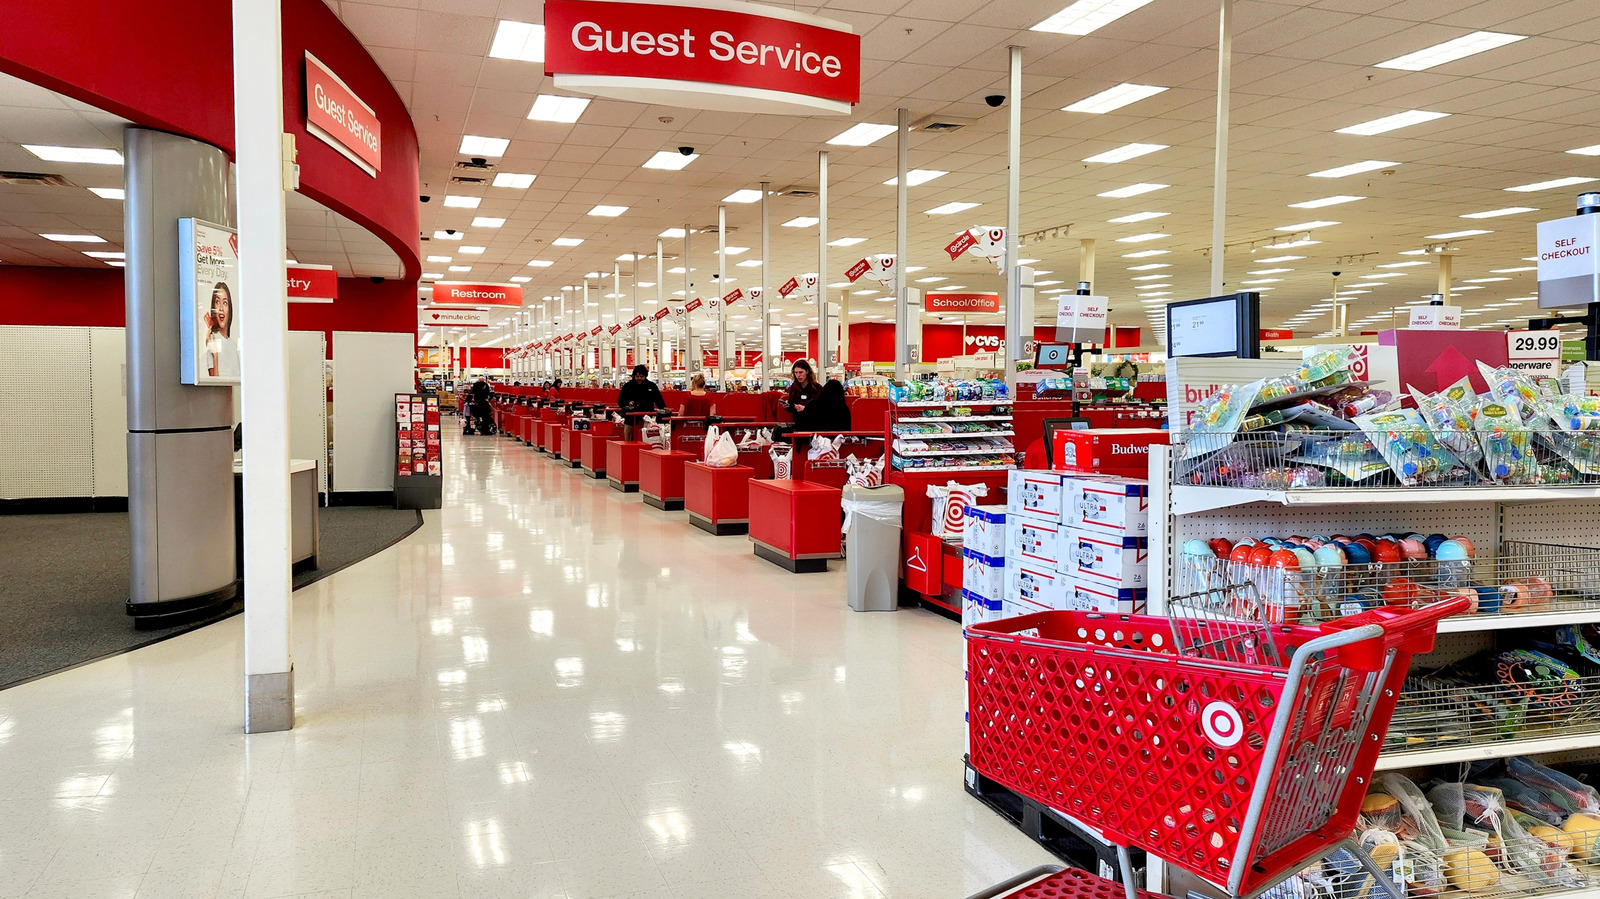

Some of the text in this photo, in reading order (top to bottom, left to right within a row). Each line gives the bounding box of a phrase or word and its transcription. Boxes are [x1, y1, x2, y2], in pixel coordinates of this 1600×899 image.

[571, 21, 842, 78] Guest Service
[314, 83, 378, 153] Guest Service
[1555, 237, 1576, 248] SELF
[1541, 246, 1591, 260] CHECKOUT
[197, 253, 209, 265] Get
[197, 264, 215, 278] Every
[451, 289, 506, 299] Restroom
[933, 298, 995, 308] School/Office
[975, 335, 999, 346] CVS
[1515, 337, 1558, 350] 29.99
[1025, 344, 1032, 352] 24
[1080, 502, 1098, 511] ULTRA
[1075, 550, 1094, 560] ULTRA
[1018, 581, 1033, 590] ULTRA
[1071, 599, 1090, 610] ULTRA
